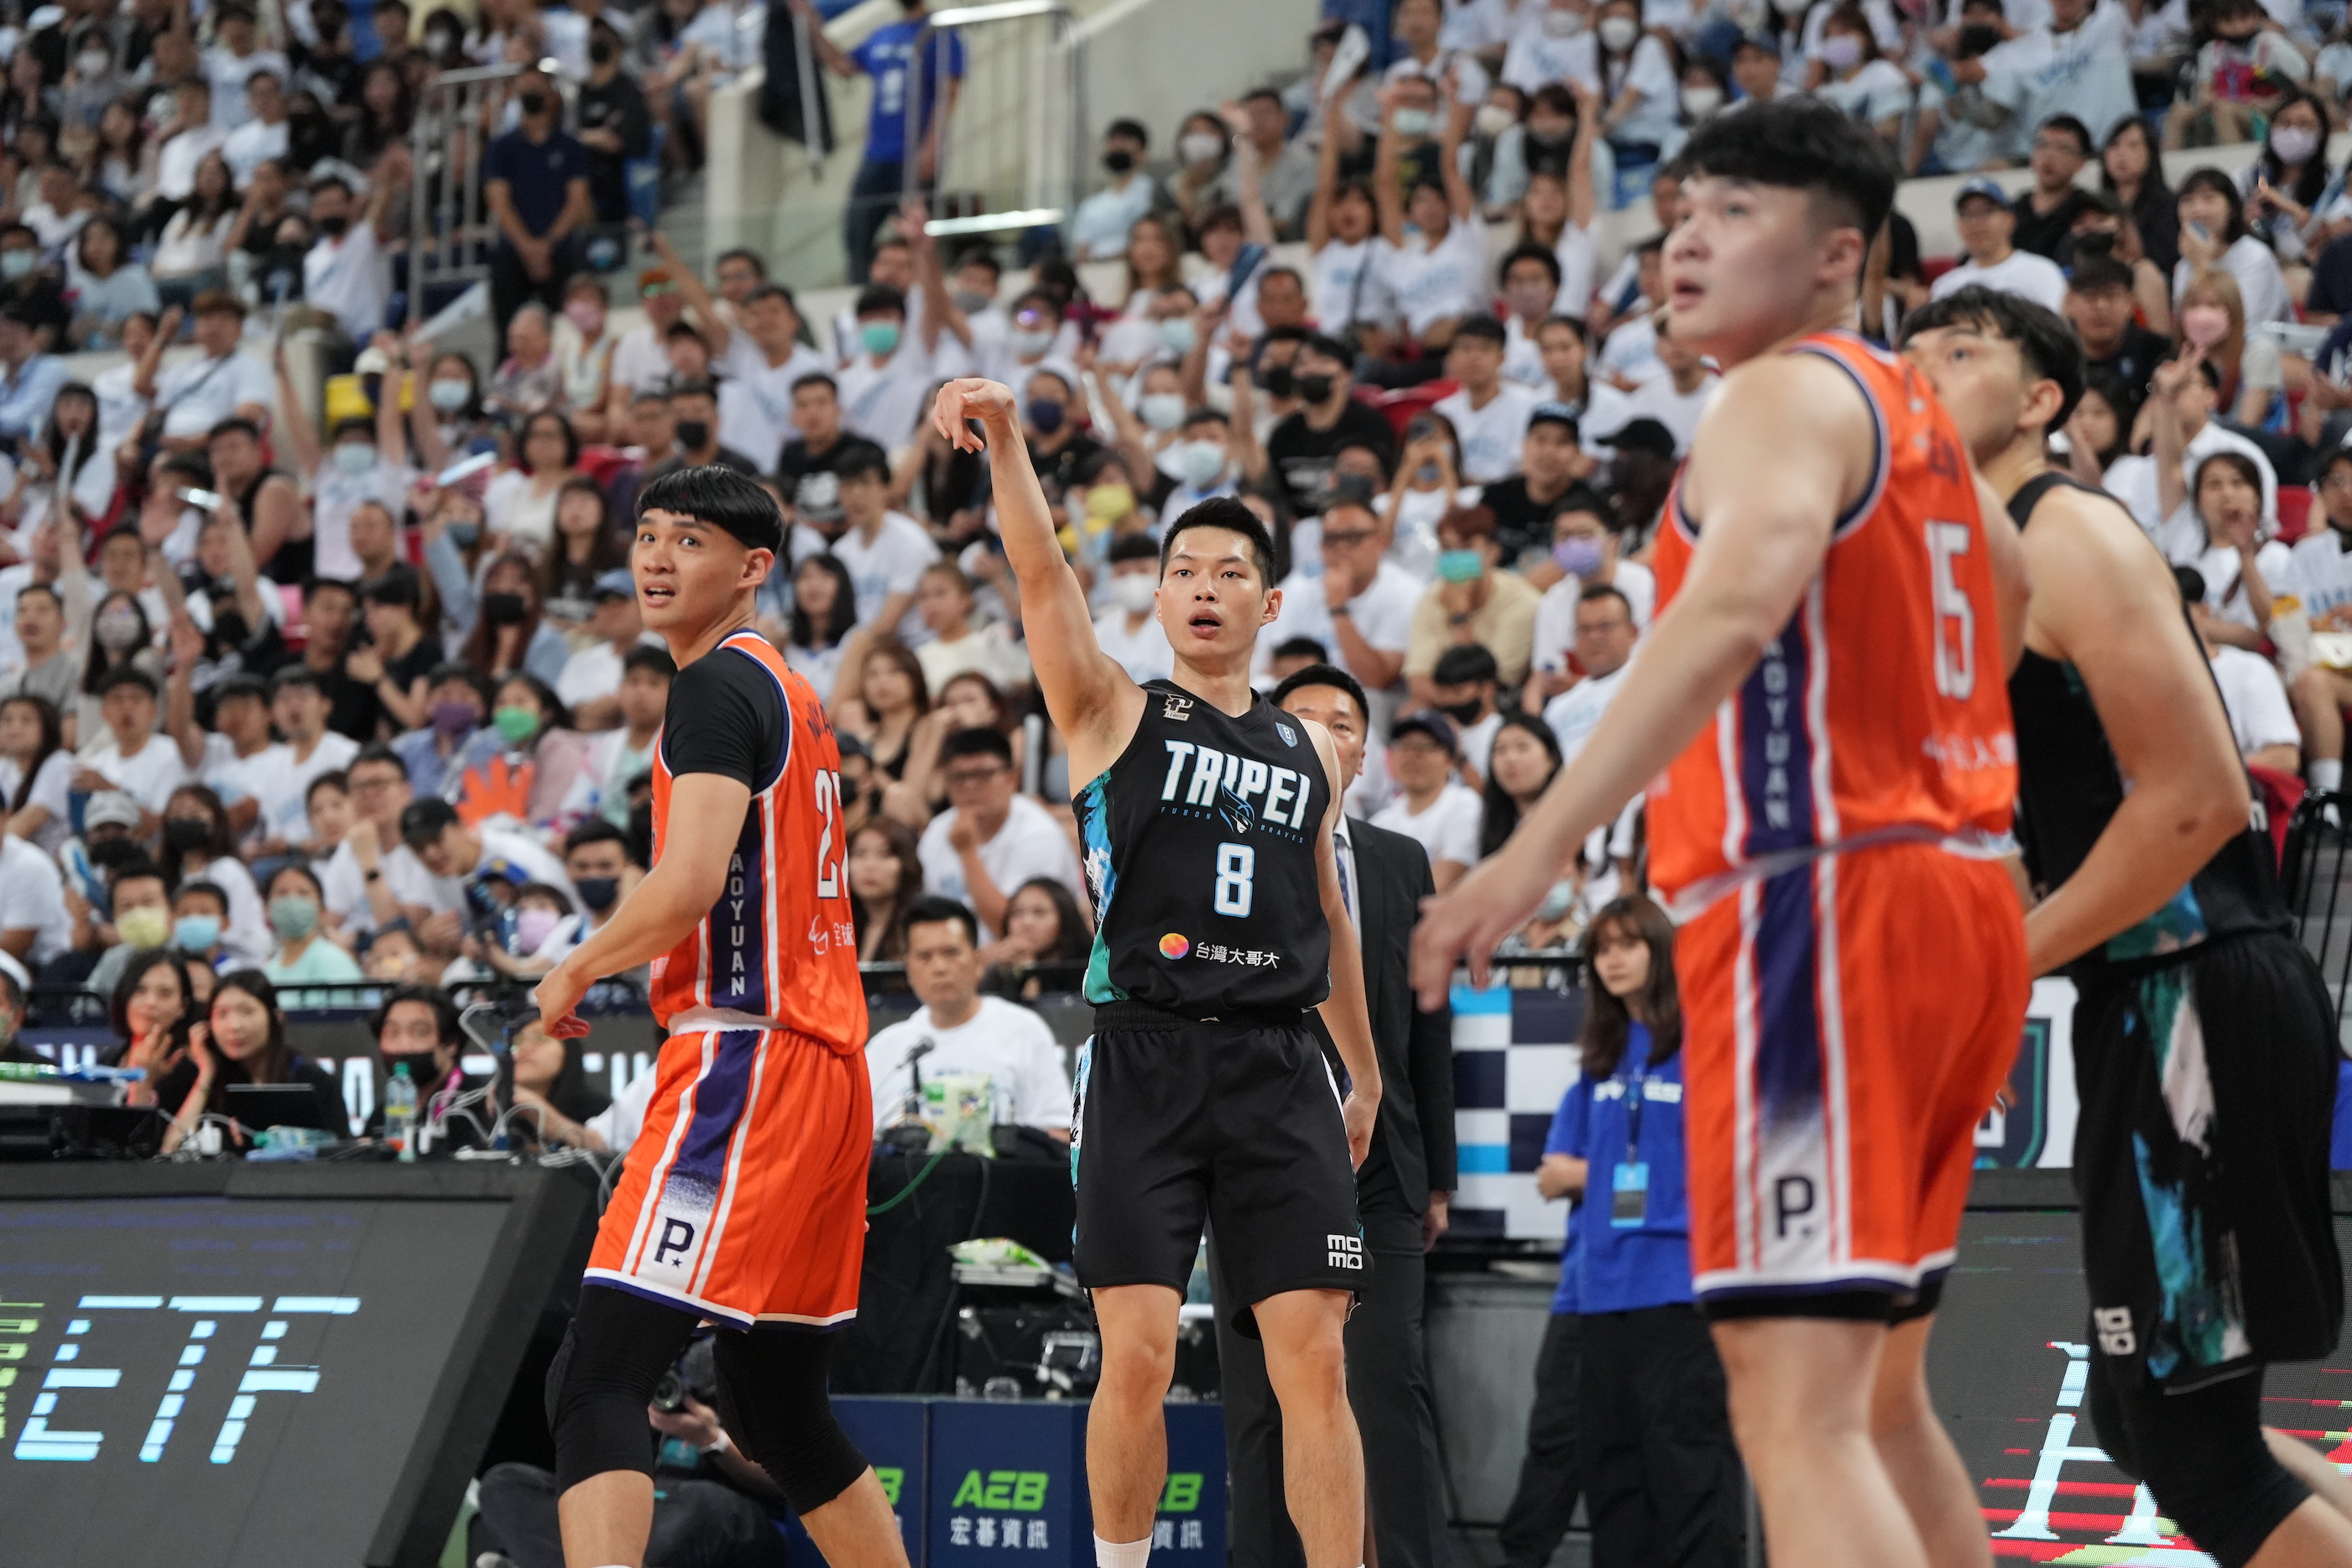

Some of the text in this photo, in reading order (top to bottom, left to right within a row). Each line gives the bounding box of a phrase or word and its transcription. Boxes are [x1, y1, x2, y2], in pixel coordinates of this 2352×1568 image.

[1763, 638, 1791, 831] AOYUAN
[1160, 739, 1312, 831] TAIPEI
[1160, 806, 1304, 844] FUBON BRAVES
[1213, 841, 1255, 918] 8
[729, 852, 746, 998] AOYUAN
[1196, 941, 1280, 970] 台灣大哥大
[654, 1216, 695, 1263] P
[13, 1295, 362, 1464] ETF
[952, 1468, 1048, 1512] AEB
[1153, 1519, 1203, 1550] 資訊
